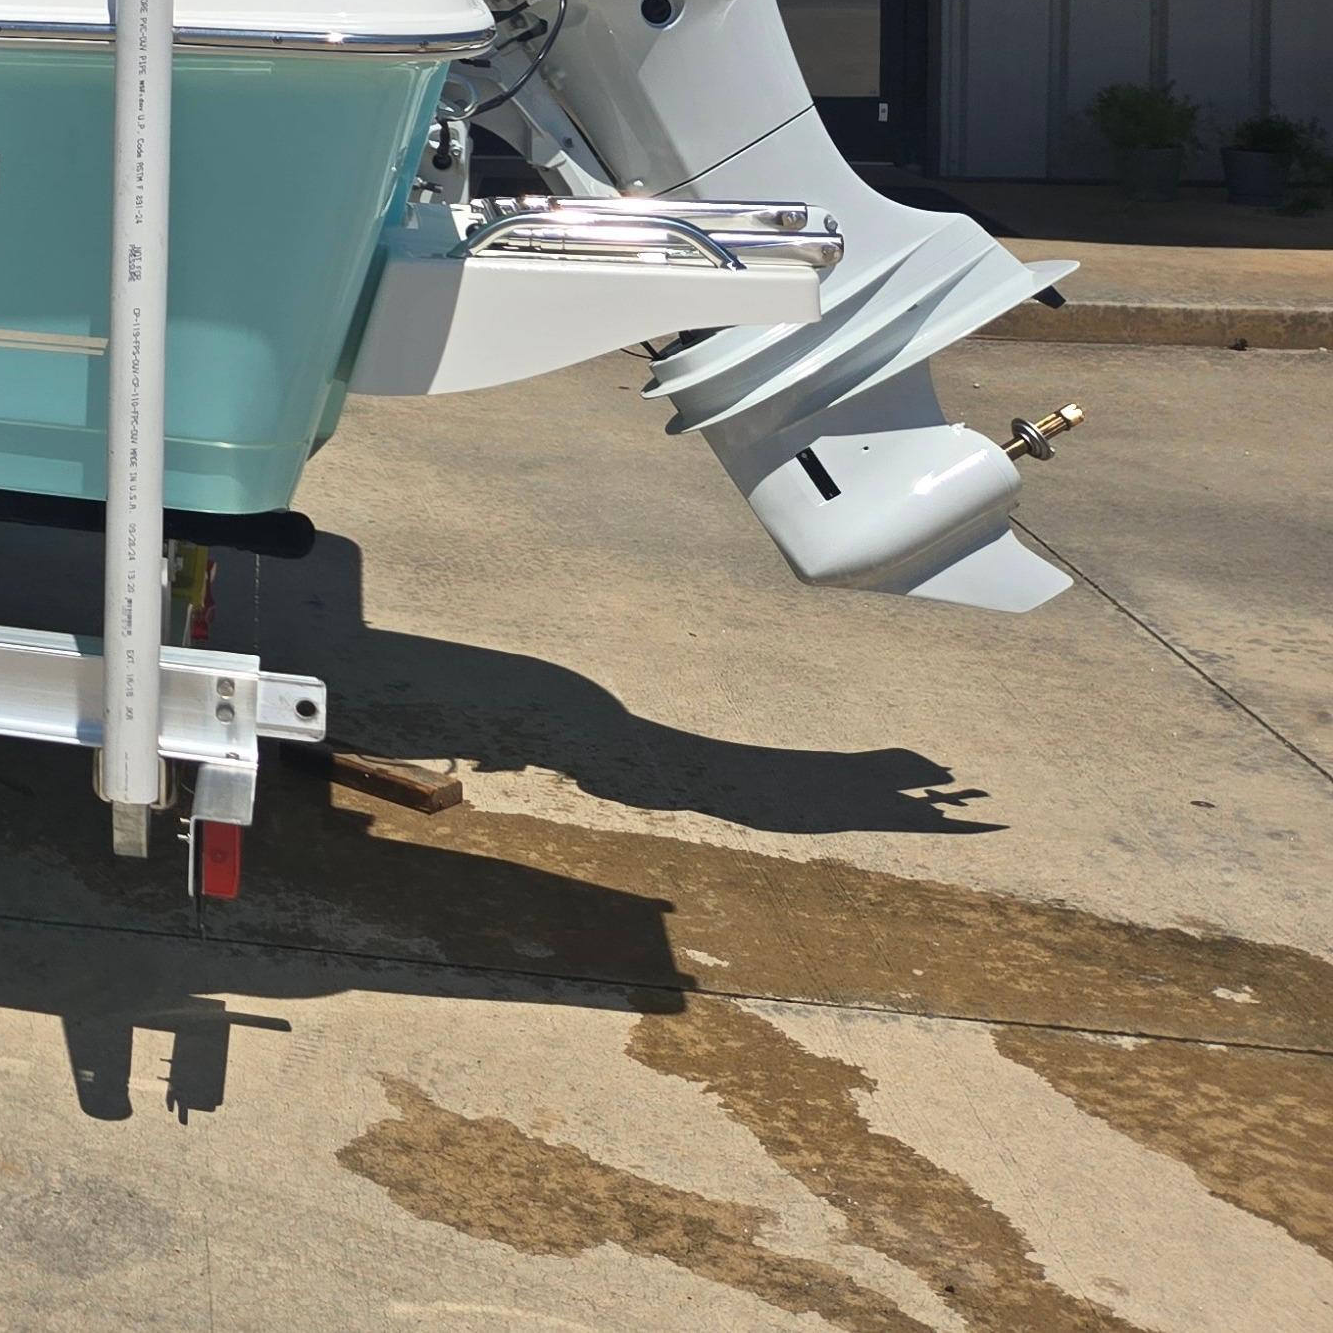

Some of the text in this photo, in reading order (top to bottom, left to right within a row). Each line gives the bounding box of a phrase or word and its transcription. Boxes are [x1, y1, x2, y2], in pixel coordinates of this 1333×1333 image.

[138, 55, 148, 75] PIPE
[136, 138, 145, 158] Code
[129, 448, 138, 467] MADE
[129, 472, 138, 482] IN
